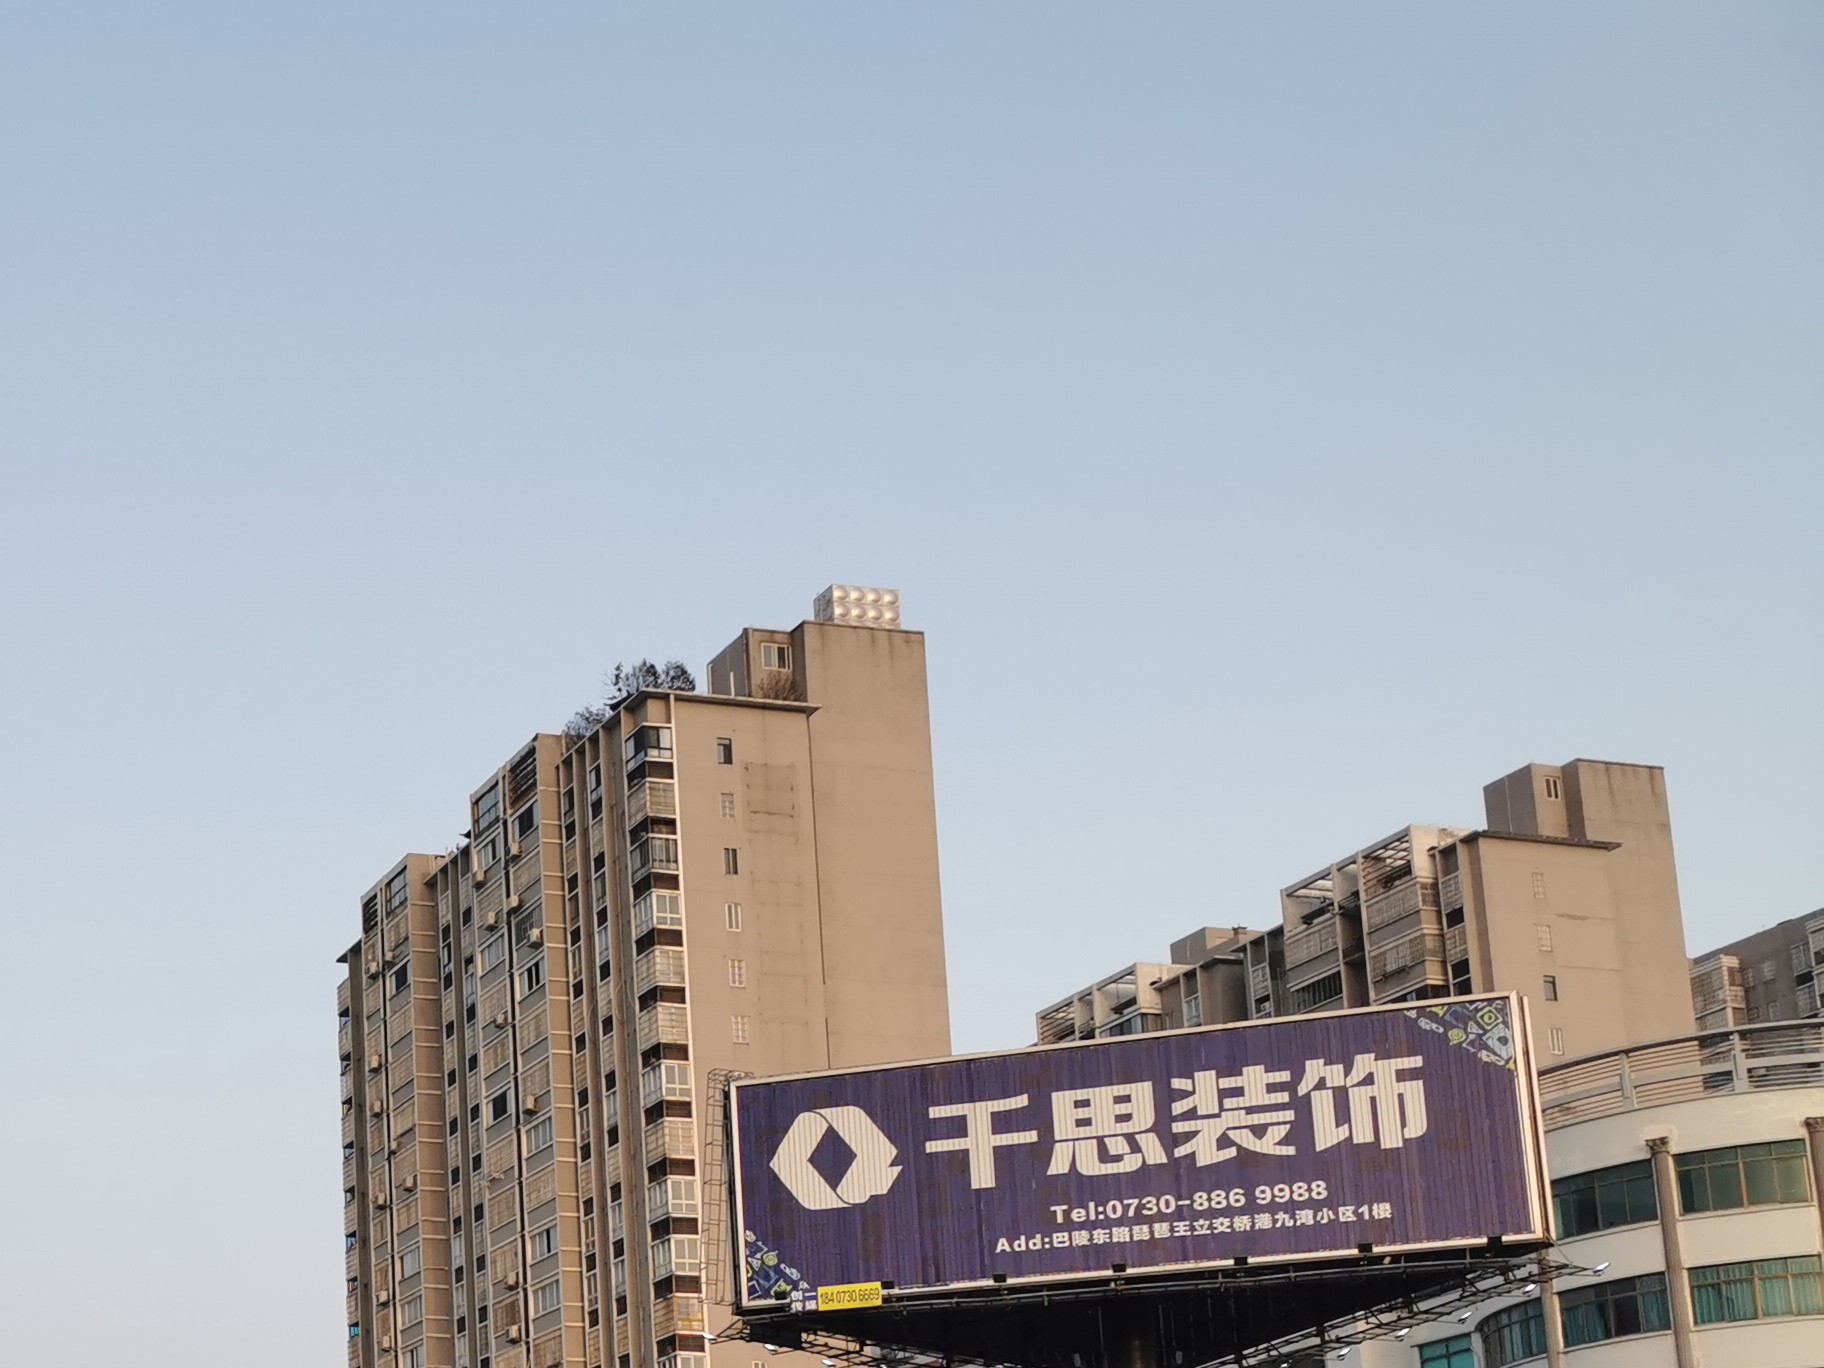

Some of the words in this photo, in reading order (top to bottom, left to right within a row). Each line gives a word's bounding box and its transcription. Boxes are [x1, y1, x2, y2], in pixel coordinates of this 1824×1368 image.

[925, 1054, 1429, 1190] 千思装饰
[1050, 1187, 1246, 1224] Tel:0730-886
[1254, 1180, 1329, 1203] 9988
